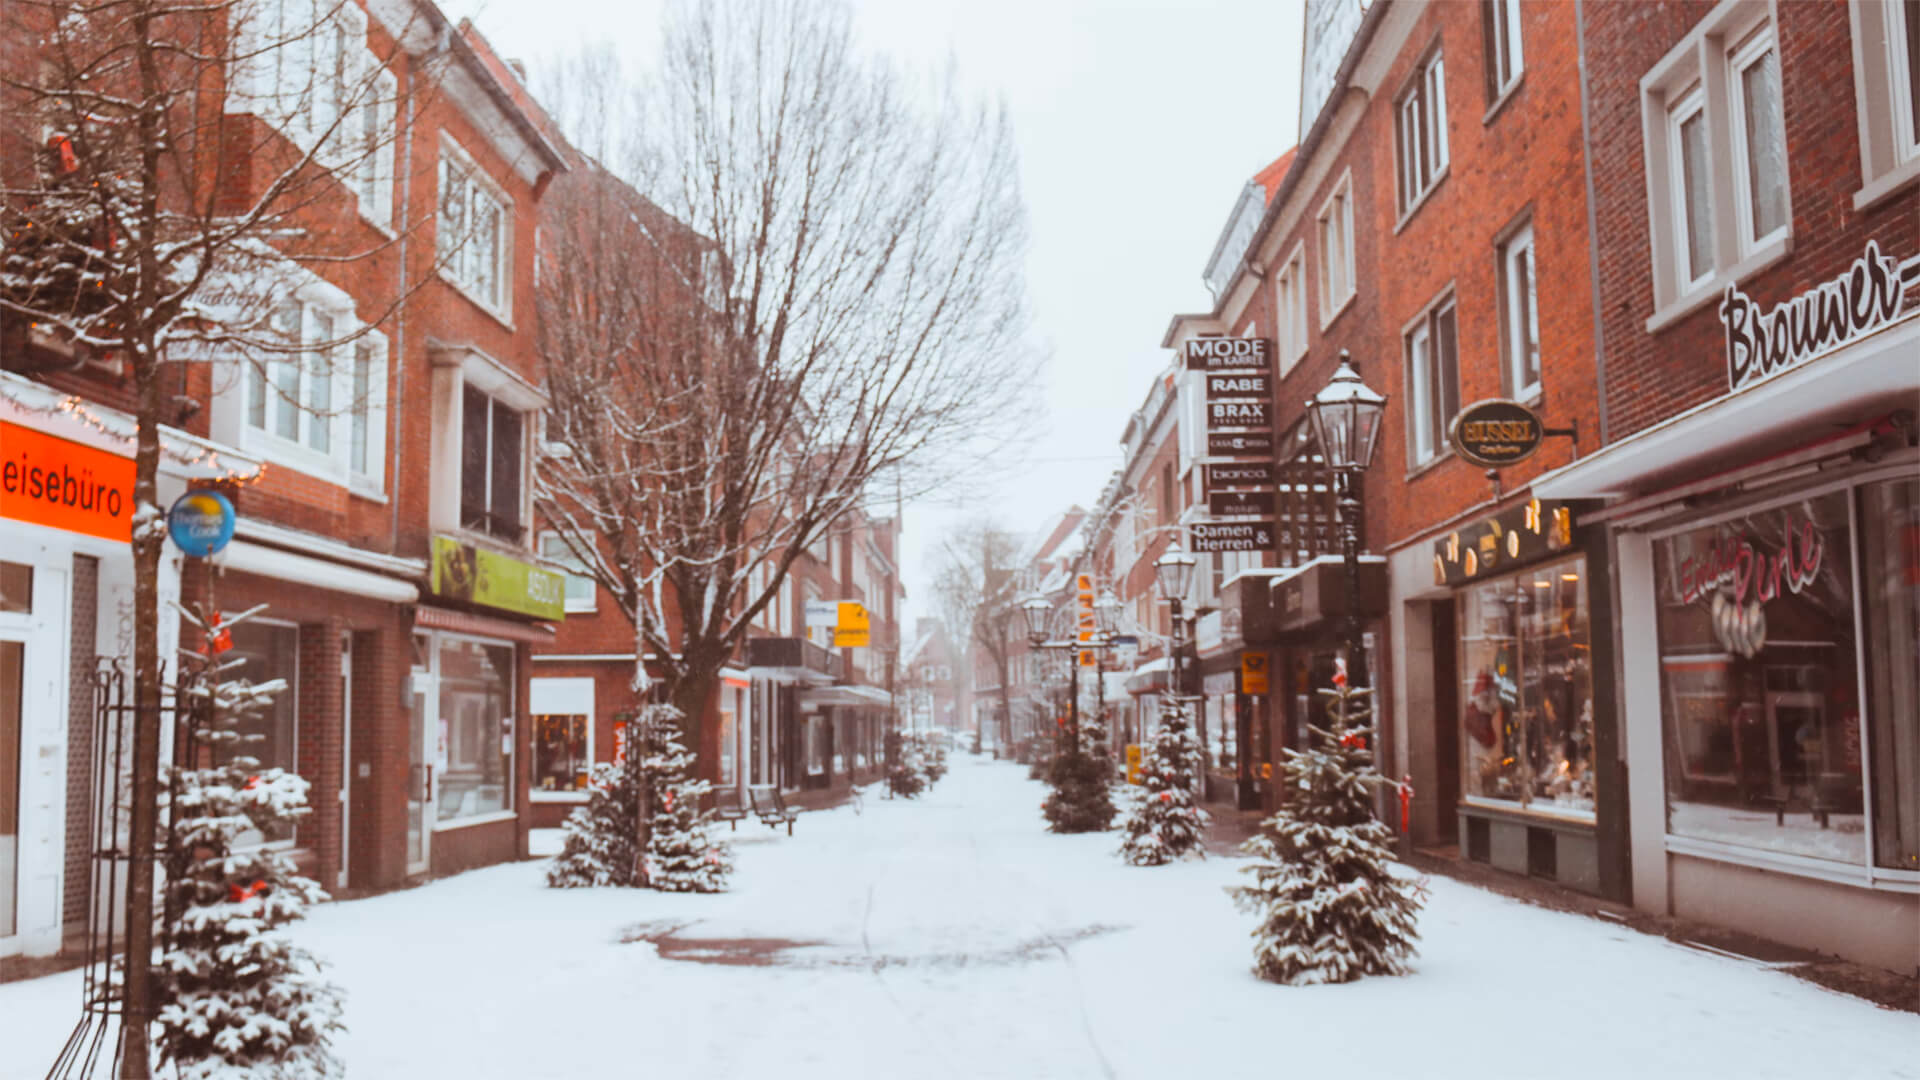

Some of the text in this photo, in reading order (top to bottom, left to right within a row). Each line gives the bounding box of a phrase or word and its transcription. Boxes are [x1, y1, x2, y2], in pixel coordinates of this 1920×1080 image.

[1189, 340, 1265, 358] MODE
[1211, 379, 1265, 392] RABE
[1213, 404, 1264, 417] BRAX
[1195, 525, 1253, 538] Damen
[1256, 531, 1270, 545] &
[1196, 538, 1253, 551] Herren
